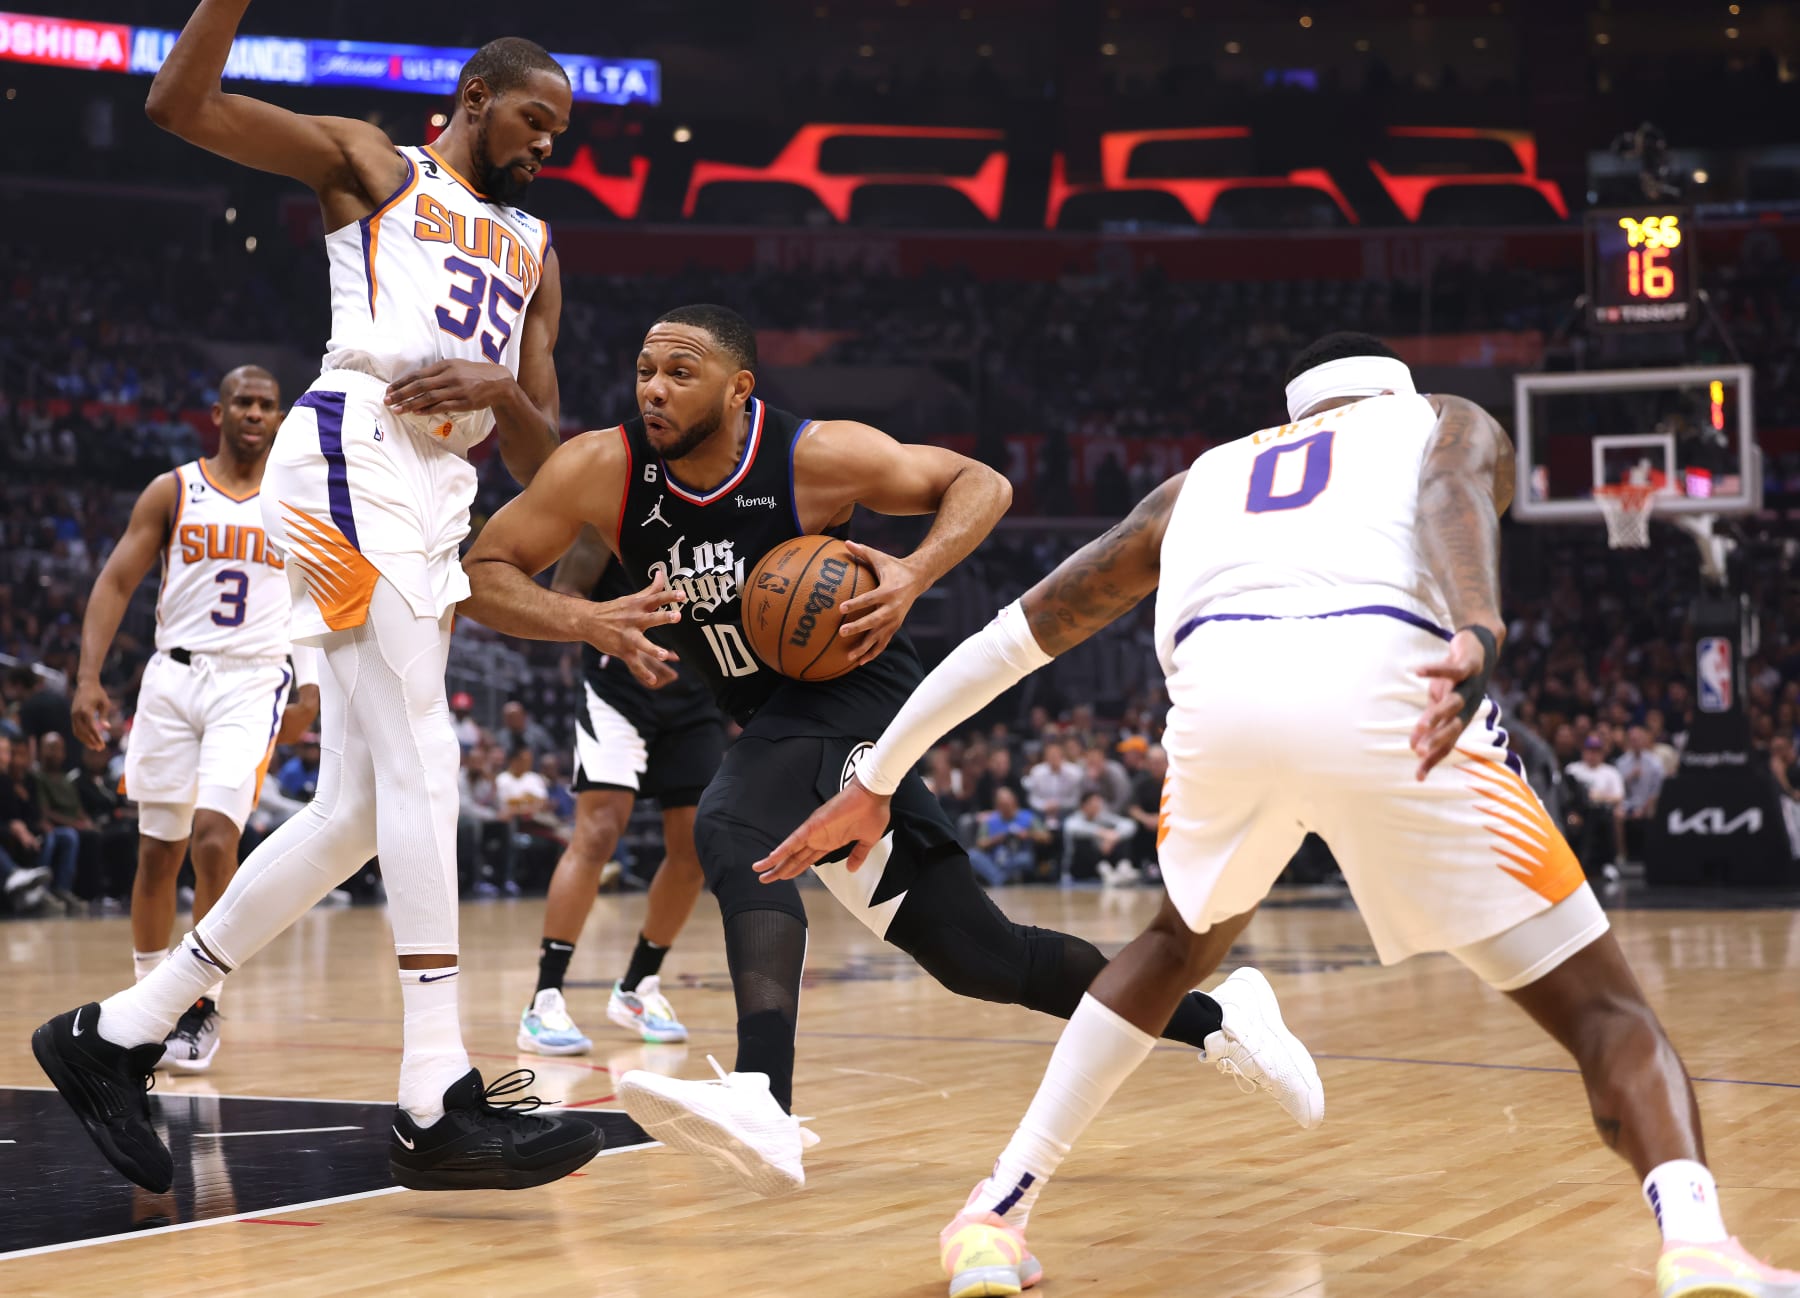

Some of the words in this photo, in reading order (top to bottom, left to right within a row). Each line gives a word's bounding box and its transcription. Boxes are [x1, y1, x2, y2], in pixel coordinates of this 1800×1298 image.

[562, 64, 648, 97] ELTA
[1628, 249, 1674, 298] 16
[435, 255, 525, 365] 35
[643, 463, 658, 483] 6
[1245, 430, 1336, 515] 0
[734, 494, 777, 510] honey
[668, 535, 735, 579] Los
[211, 570, 249, 628] 3
[647, 556, 746, 622] Angel
[790, 557, 849, 648] Wilson
[700, 623, 760, 678] 10
